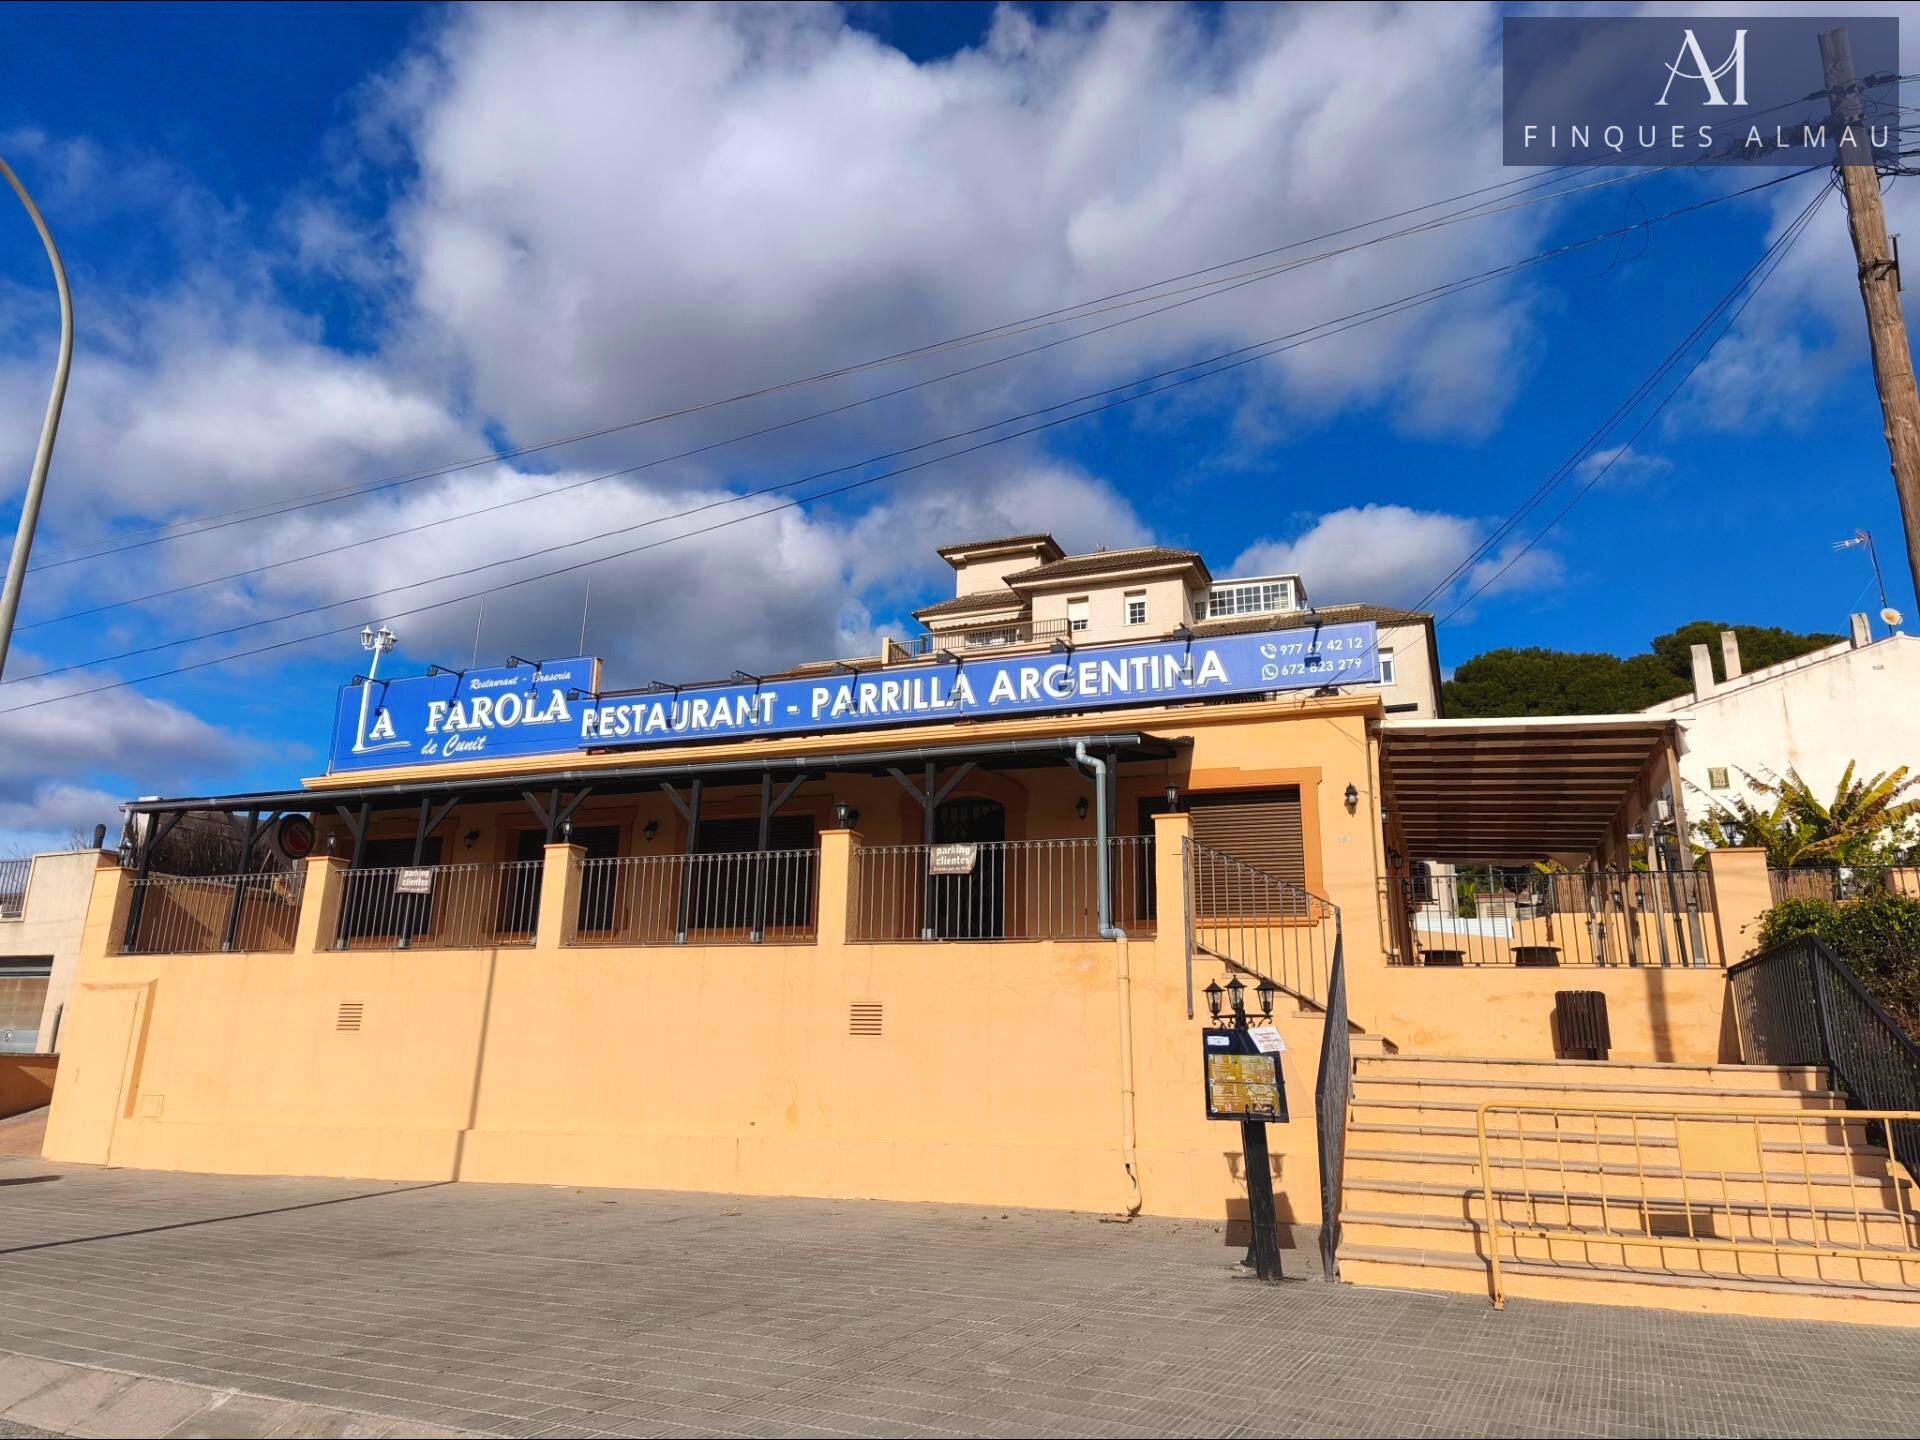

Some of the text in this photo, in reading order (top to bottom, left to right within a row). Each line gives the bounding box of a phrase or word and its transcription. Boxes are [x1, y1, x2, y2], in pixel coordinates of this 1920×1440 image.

[1280, 643, 1303, 656] 977
[1326, 639, 1343, 651] 42
[1348, 637, 1363, 649] 12
[1281, 658, 1362, 676] 672 823 279
[469, 676, 519, 690] Restaurant
[532, 671, 572, 684] Braseria
[581, 691, 778, 738] RESTAURANT
[811, 671, 978, 720] PARRILLA
[988, 650, 1232, 704] ARGENTINA
[424, 688, 573, 734] FAROLA
[421, 734, 487, 757] de Cunit
[935, 855, 970, 866] clientes
[936, 846, 971, 857] parking
[403, 869, 430, 878] parking
